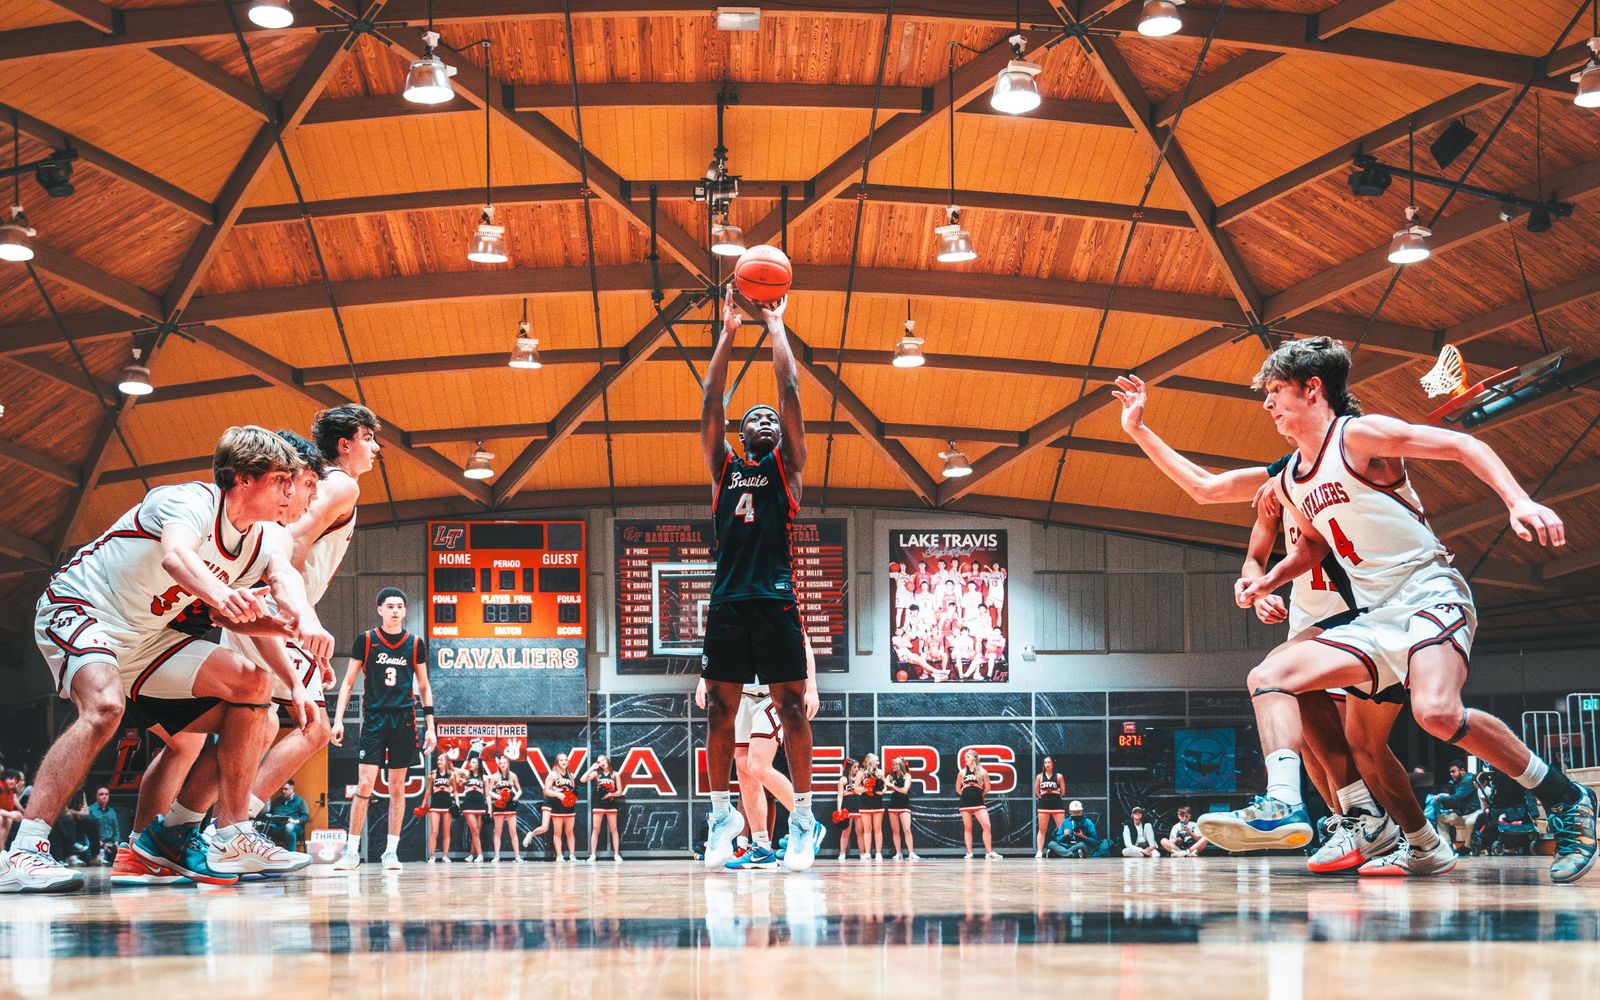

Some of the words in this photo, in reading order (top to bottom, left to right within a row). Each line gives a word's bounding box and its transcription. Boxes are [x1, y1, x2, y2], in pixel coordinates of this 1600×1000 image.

[728, 471, 768, 489] Bowie
[1301, 481, 1351, 520] VALIERS
[734, 493, 755, 523] 4
[434, 526, 463, 548] LT
[645, 532, 702, 542] BASKETBALL
[900, 534, 939, 547] LAKE
[943, 534, 998, 547] TRAVIS
[1328, 517, 1363, 566] 4
[439, 554, 471, 564] HOME
[493, 560, 520, 568] PERIOD
[542, 554, 578, 564] GUEST
[432, 595, 458, 603] FOULS
[481, 595, 510, 603] PLAYER
[513, 595, 533, 603] FOUL
[557, 595, 582, 603] FOULS
[432, 627, 459, 636] SCORE
[494, 627, 522, 636] MATCH
[556, 627, 582, 636] SCORE
[376, 653, 407, 666] Bowie
[437, 648, 579, 669] CAVALIERS
[385, 667, 397, 687] 3
[438, 725, 466, 735] THREE
[467, 725, 495, 735] CHARGE
[499, 726, 526, 735] THREE
[370, 744, 1018, 799] CVALERS
[314, 832, 343, 840] THREE
